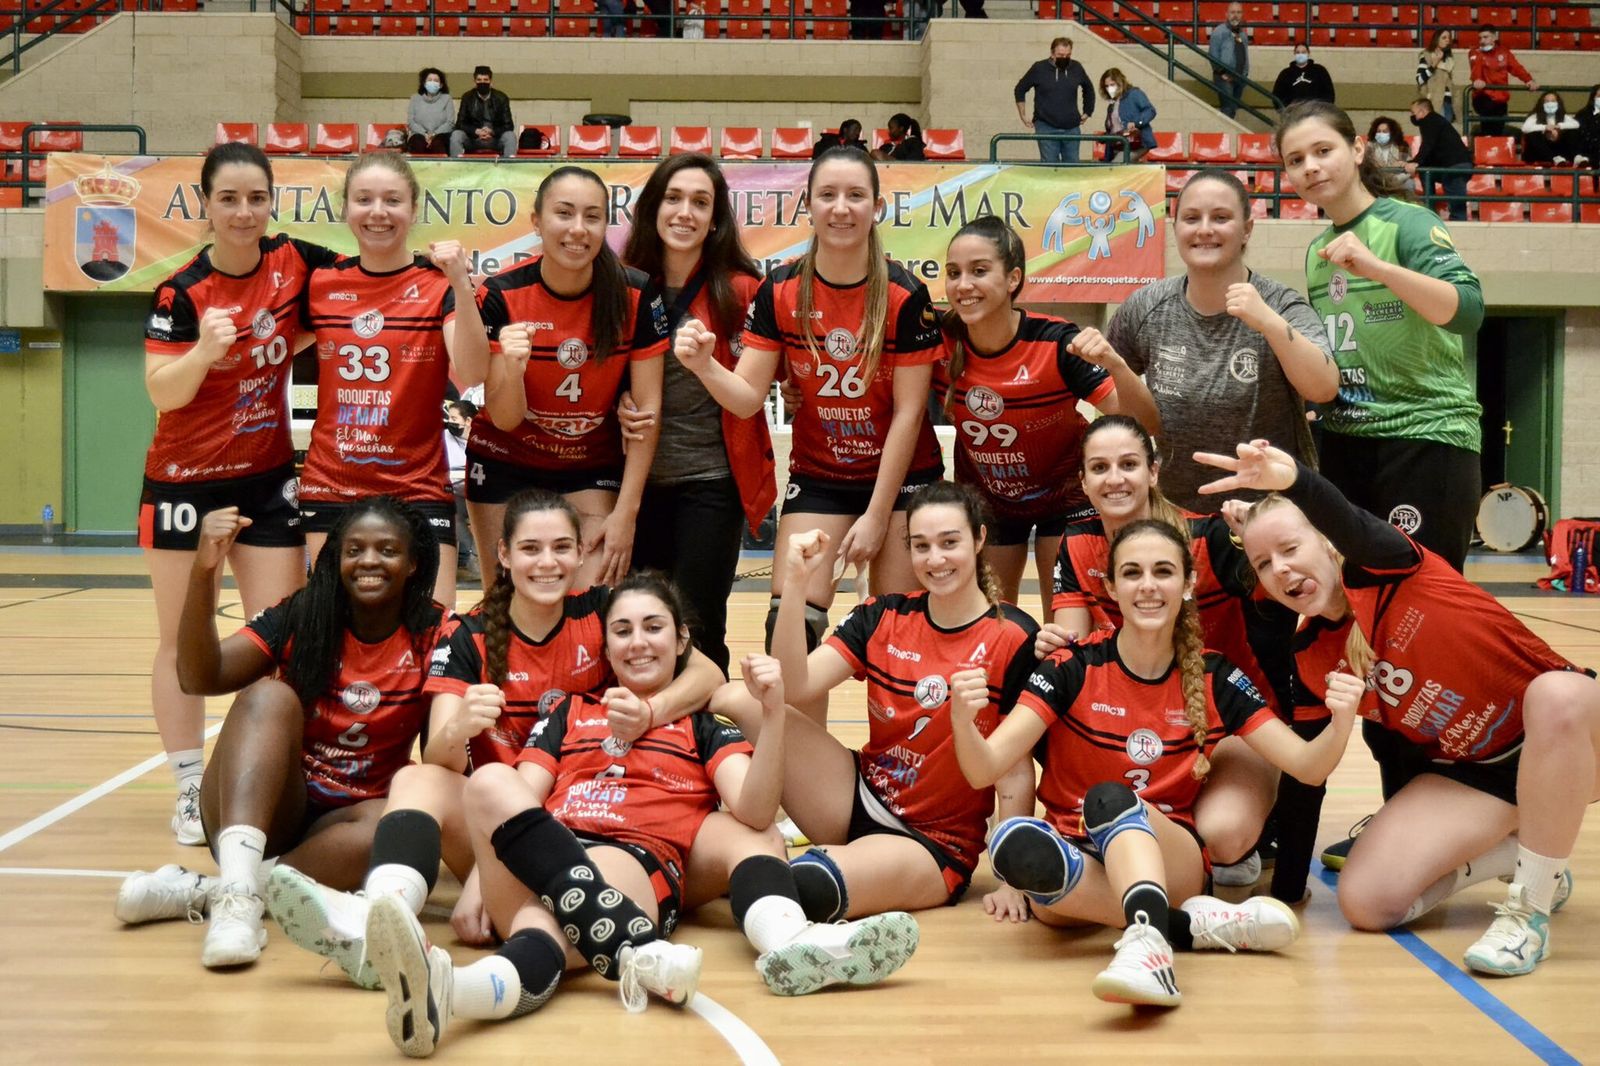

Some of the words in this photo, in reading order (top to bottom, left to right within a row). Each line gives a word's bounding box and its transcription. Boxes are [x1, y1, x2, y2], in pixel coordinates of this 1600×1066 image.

[1028, 275, 1157, 287] www.deportesroquetas.org
[1323, 312, 1357, 352] 12
[251, 335, 288, 369] 10
[338, 343, 391, 383] 33
[555, 373, 582, 403] 4
[816, 364, 866, 399] 26
[337, 388, 392, 406] ROQUETAS
[337, 405, 354, 426] DE
[355, 406, 390, 427] MAR
[817, 406, 871, 421] ROQUETAS
[335, 425, 350, 443] El
[351, 427, 382, 443] Mar
[841, 420, 877, 437] MAR
[961, 419, 1018, 448] 99
[335, 441, 356, 460] que
[355, 442, 396, 454] sueñas
[852, 447, 884, 456] sueña
[470, 462, 486, 486] 4
[991, 463, 1031, 479] MAR
[1497, 492, 1512, 502] NP
[159, 501, 198, 533] 10
[1373, 660, 1414, 708] 18
[1400, 679, 1442, 729] ROQUETAS
[1429, 689, 1465, 730] MAR
[338, 722, 369, 748] 6
[1445, 710, 1476, 739] Mar
[1123, 768, 1151, 793] 3
